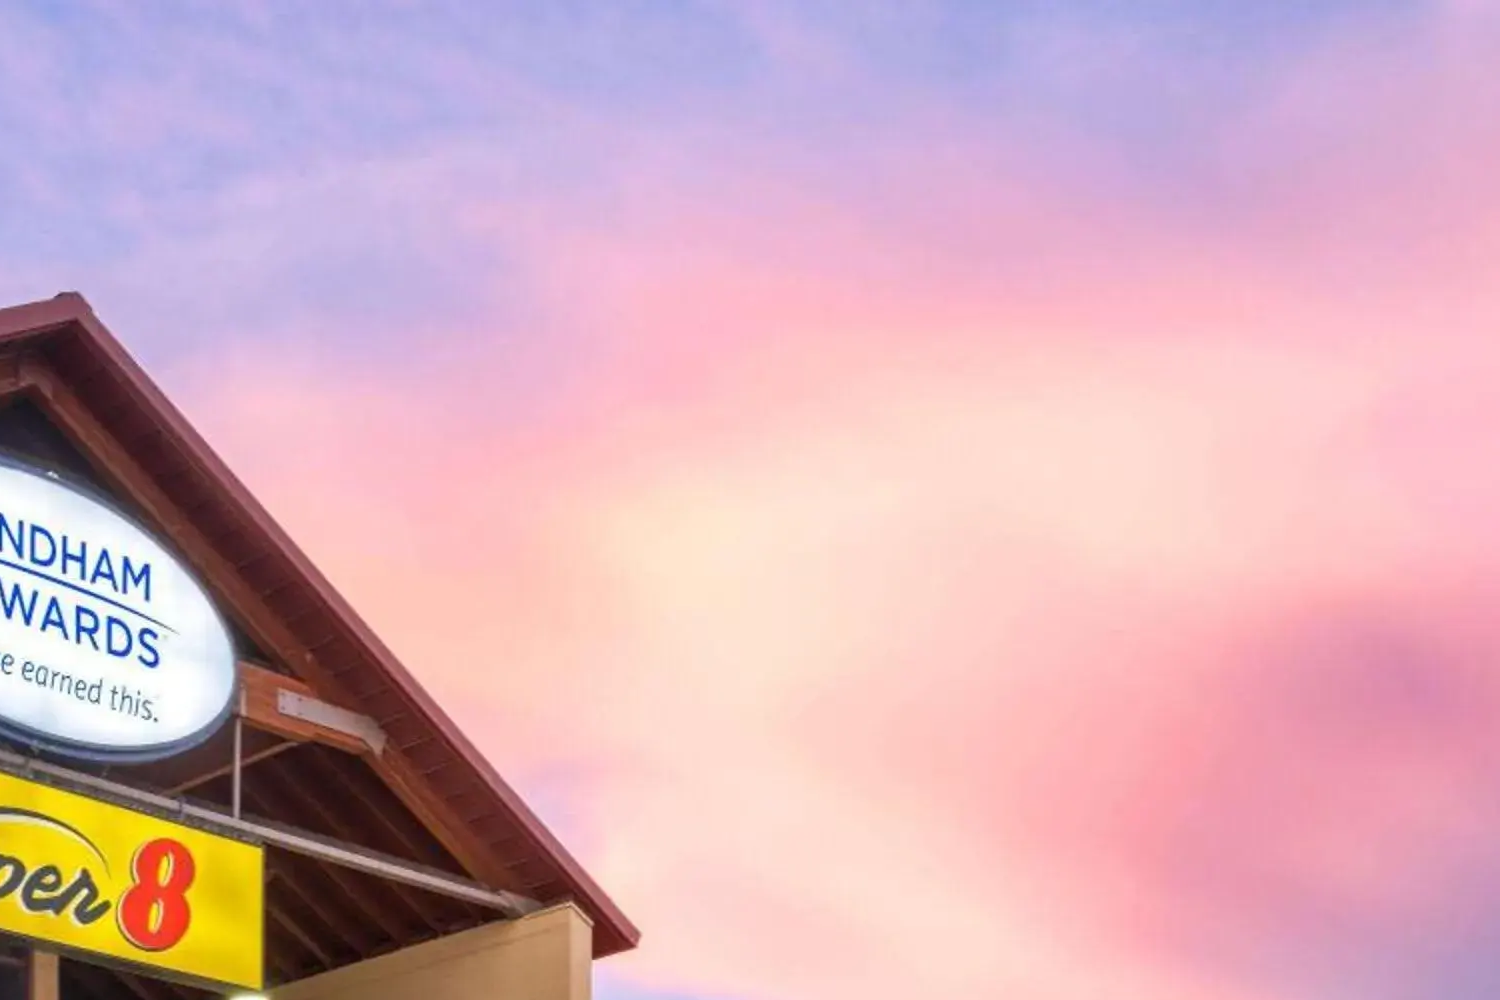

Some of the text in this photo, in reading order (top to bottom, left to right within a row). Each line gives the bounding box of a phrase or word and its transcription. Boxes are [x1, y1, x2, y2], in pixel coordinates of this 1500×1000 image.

[21, 659, 103, 705] earned
[110, 684, 158, 723] this.
[116, 837, 196, 953] 8
